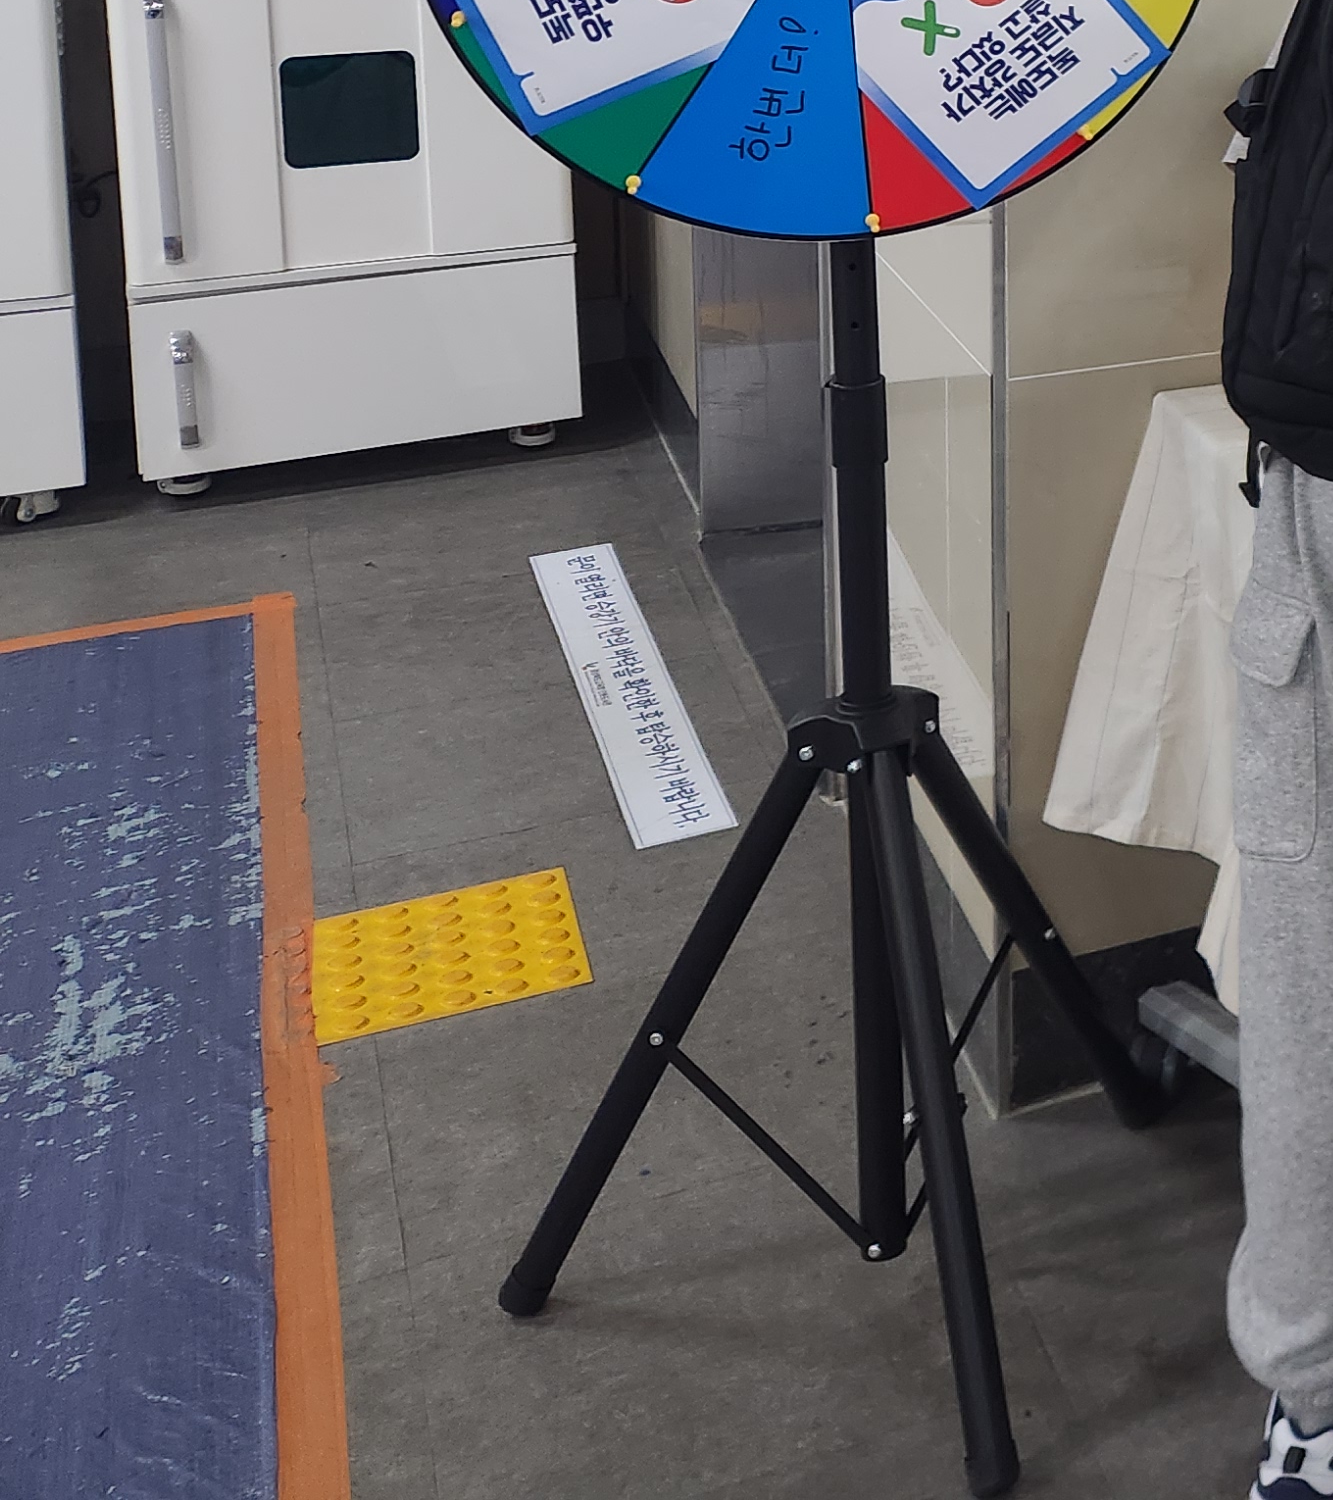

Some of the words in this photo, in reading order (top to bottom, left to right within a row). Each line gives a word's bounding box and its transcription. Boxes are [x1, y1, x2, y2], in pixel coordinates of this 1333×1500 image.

[1009, 6, 1085, 68] 지금도
[939, 31, 1006, 92] 있다?
[941, 58, 1017, 123] 강치가
[983, 47, 1080, 120] 독도에는
[567, 555, 601, 575] 문이
[574, 573, 613, 602] 열리면
[584, 601, 626, 628] 승강기
[598, 626, 635, 649] 안의
[606, 647, 645, 679] 바닥을
[617, 677, 660, 711] 확인한
[635, 721, 690, 780] 탑승하시기
[659, 777, 710, 829] 바랍니다.
